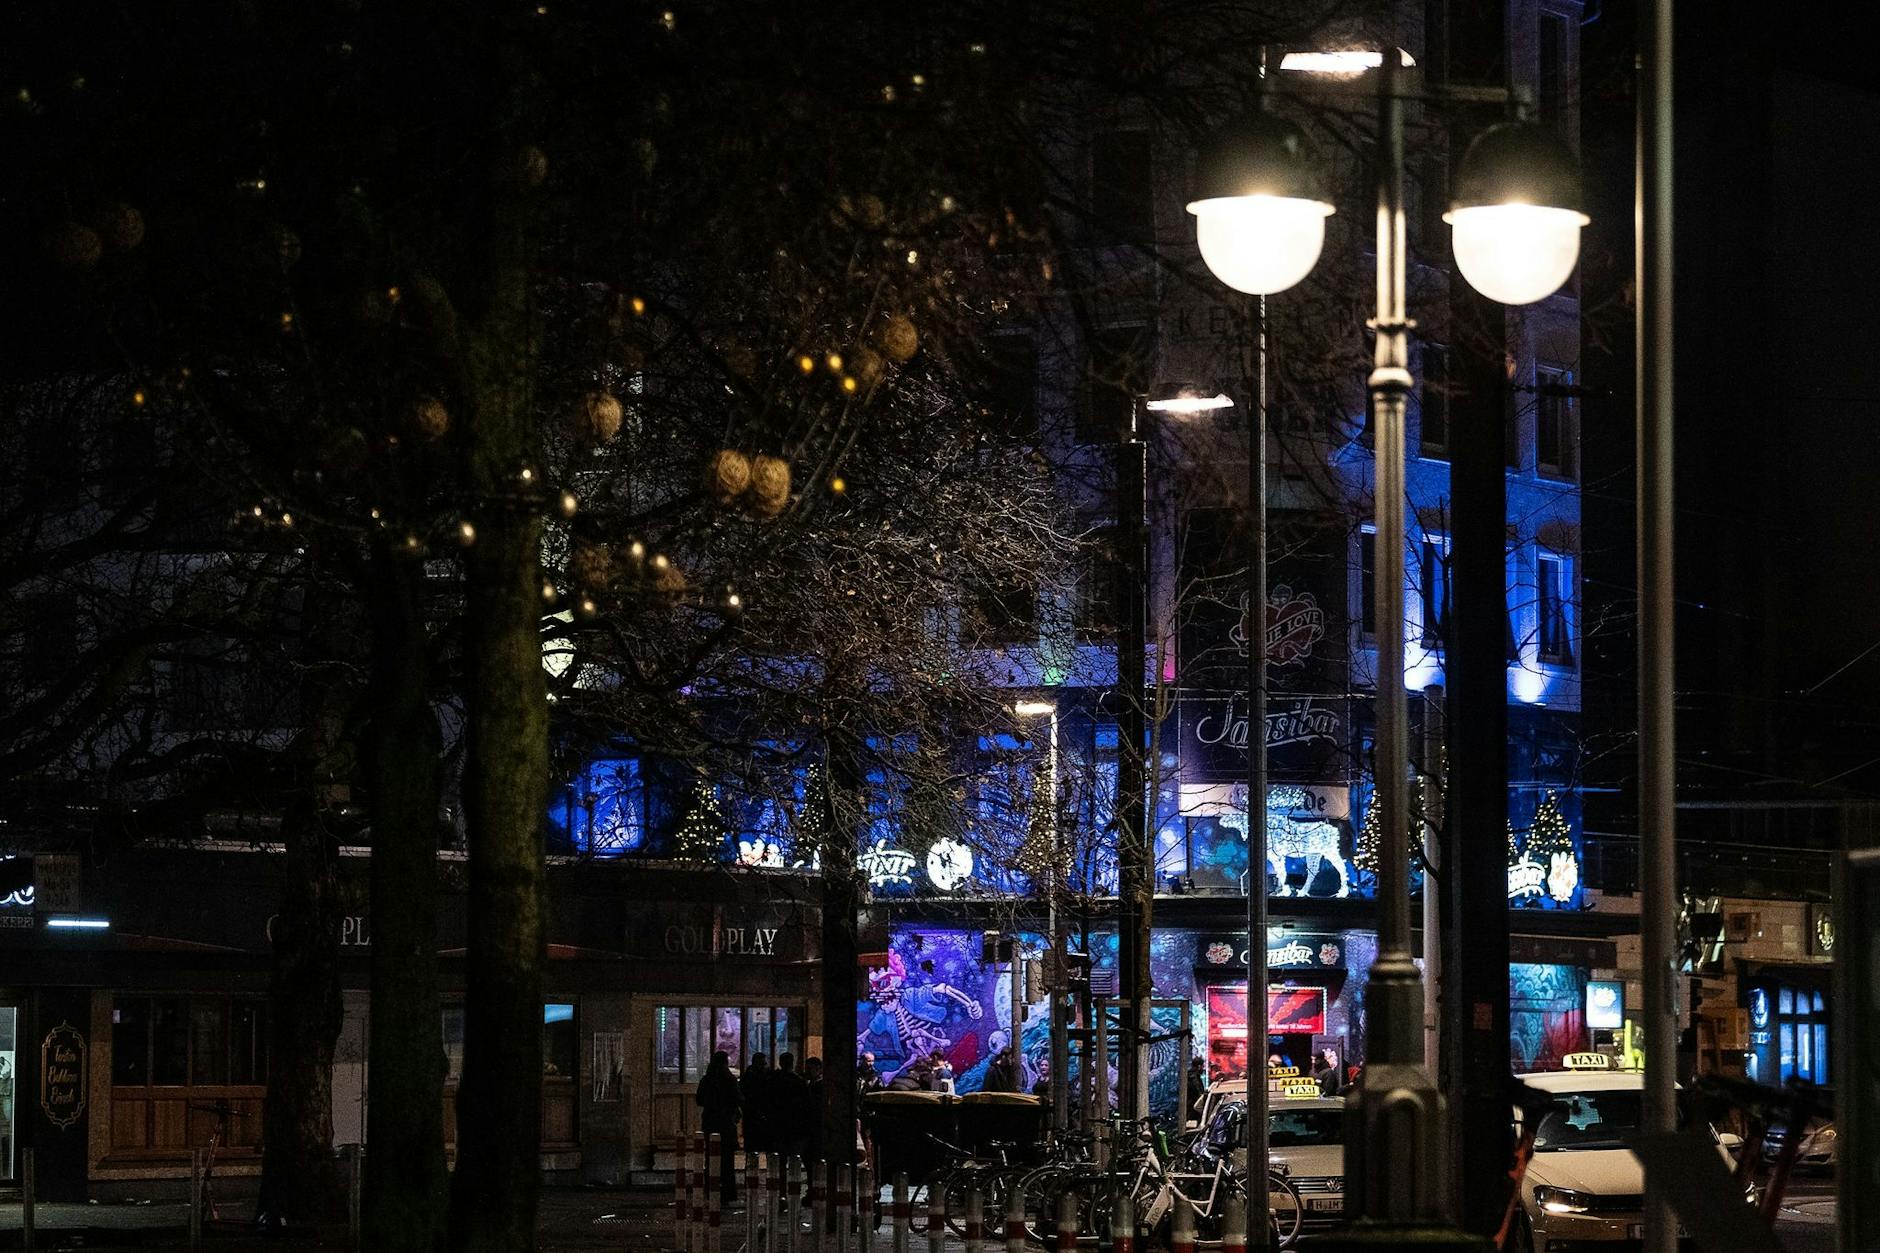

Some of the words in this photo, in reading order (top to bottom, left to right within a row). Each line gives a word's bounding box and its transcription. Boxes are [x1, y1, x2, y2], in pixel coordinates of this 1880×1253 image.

[1287, 611, 1320, 634] LOVE
[1571, 1055, 1604, 1065] TAXI
[1288, 1086, 1315, 1095] TAXI
